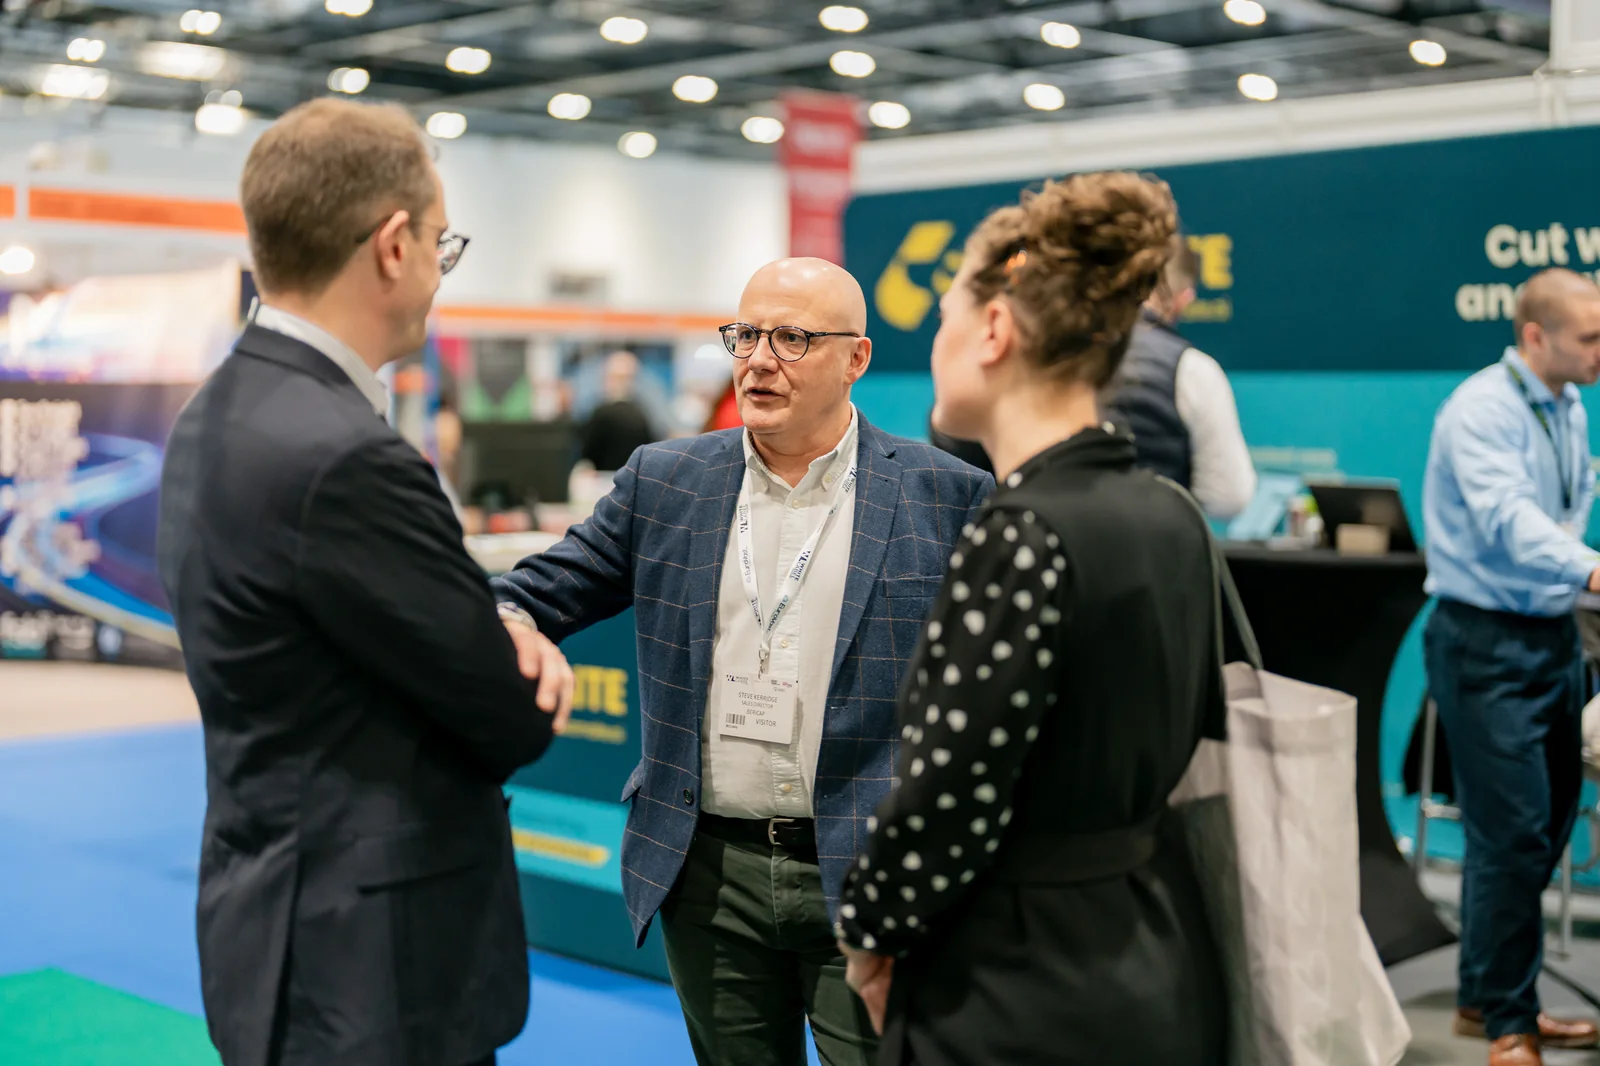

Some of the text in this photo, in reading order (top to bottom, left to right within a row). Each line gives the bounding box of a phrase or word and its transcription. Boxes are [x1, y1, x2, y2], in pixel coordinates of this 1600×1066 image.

[1485, 222, 1569, 269] Cut
[1455, 282, 1525, 321] an
[738, 691, 778, 704] STEVE KERRIDGE
[755, 718, 777, 727] VISITOR
